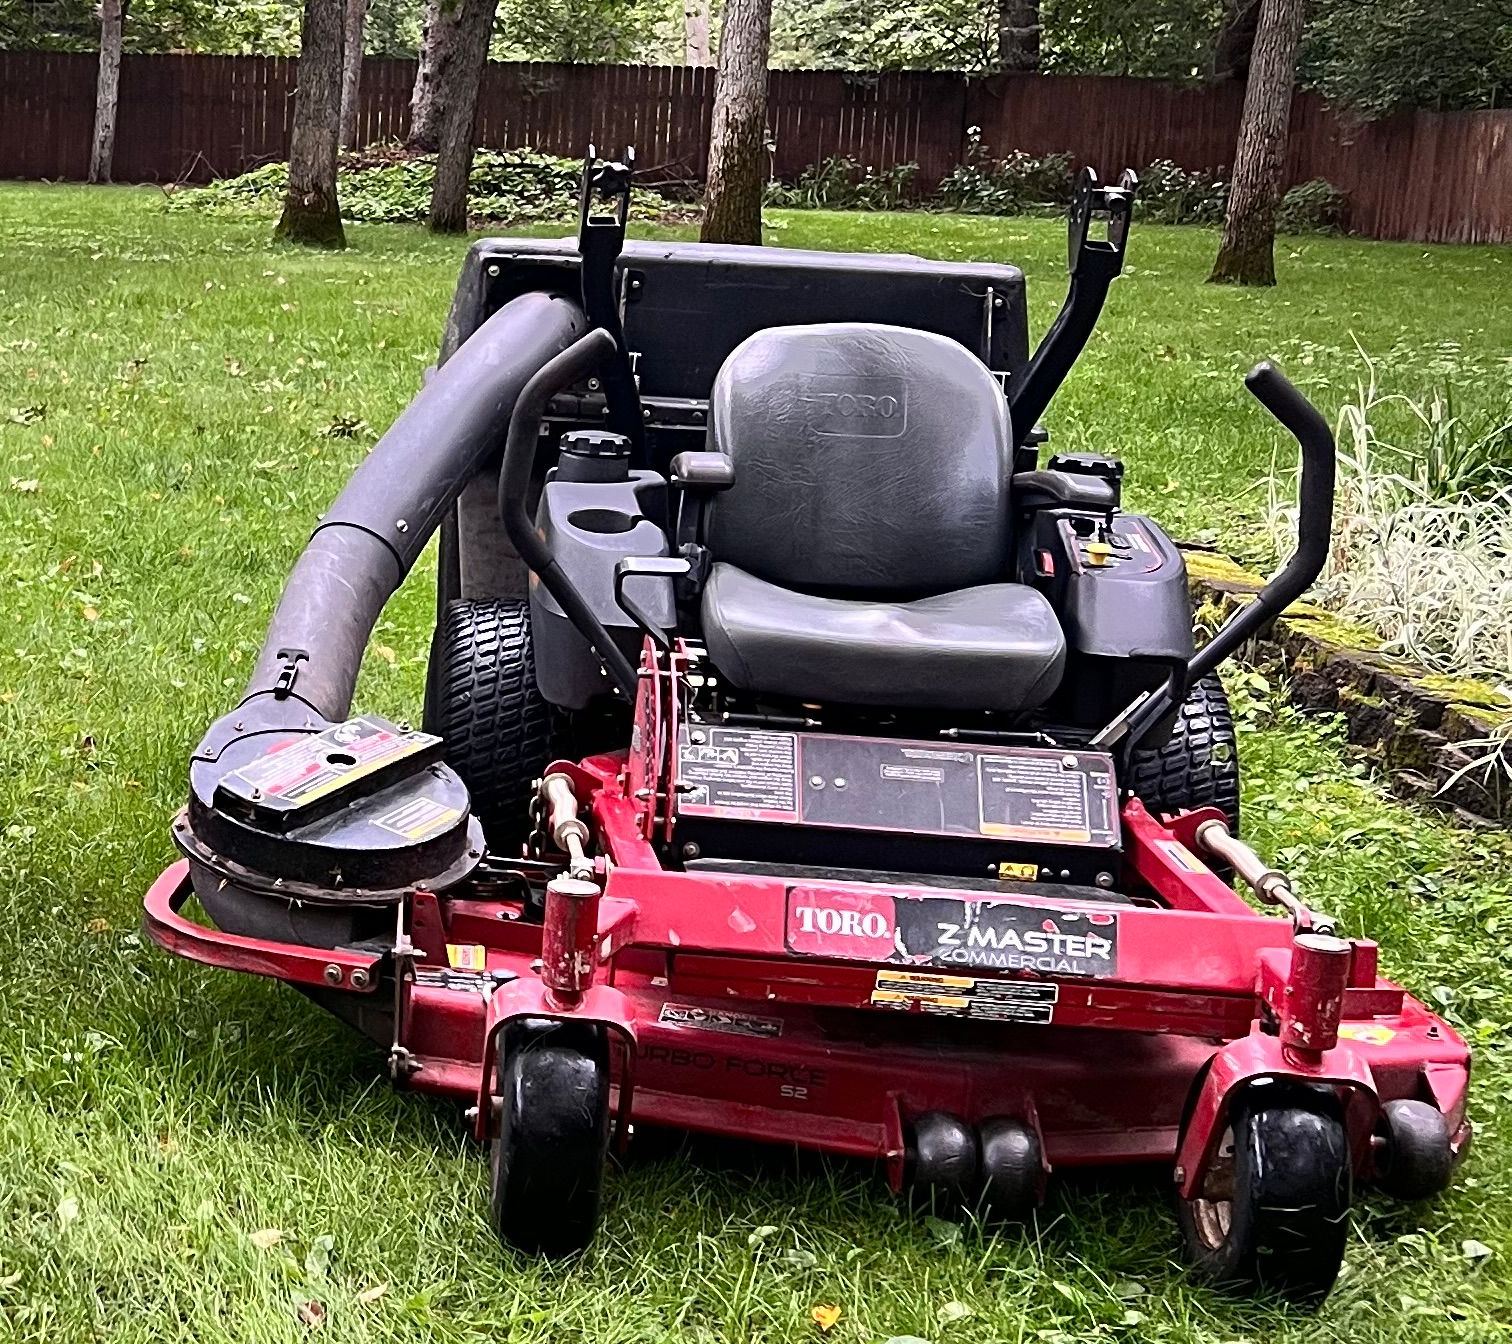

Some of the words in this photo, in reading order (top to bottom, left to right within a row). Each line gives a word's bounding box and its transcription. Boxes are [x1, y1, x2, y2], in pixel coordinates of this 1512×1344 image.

[795, 906, 889, 939] TORO
[936, 922, 961, 945] Z
[967, 924, 1113, 960] MASTER
[725, 1058, 827, 1086] FORCE
